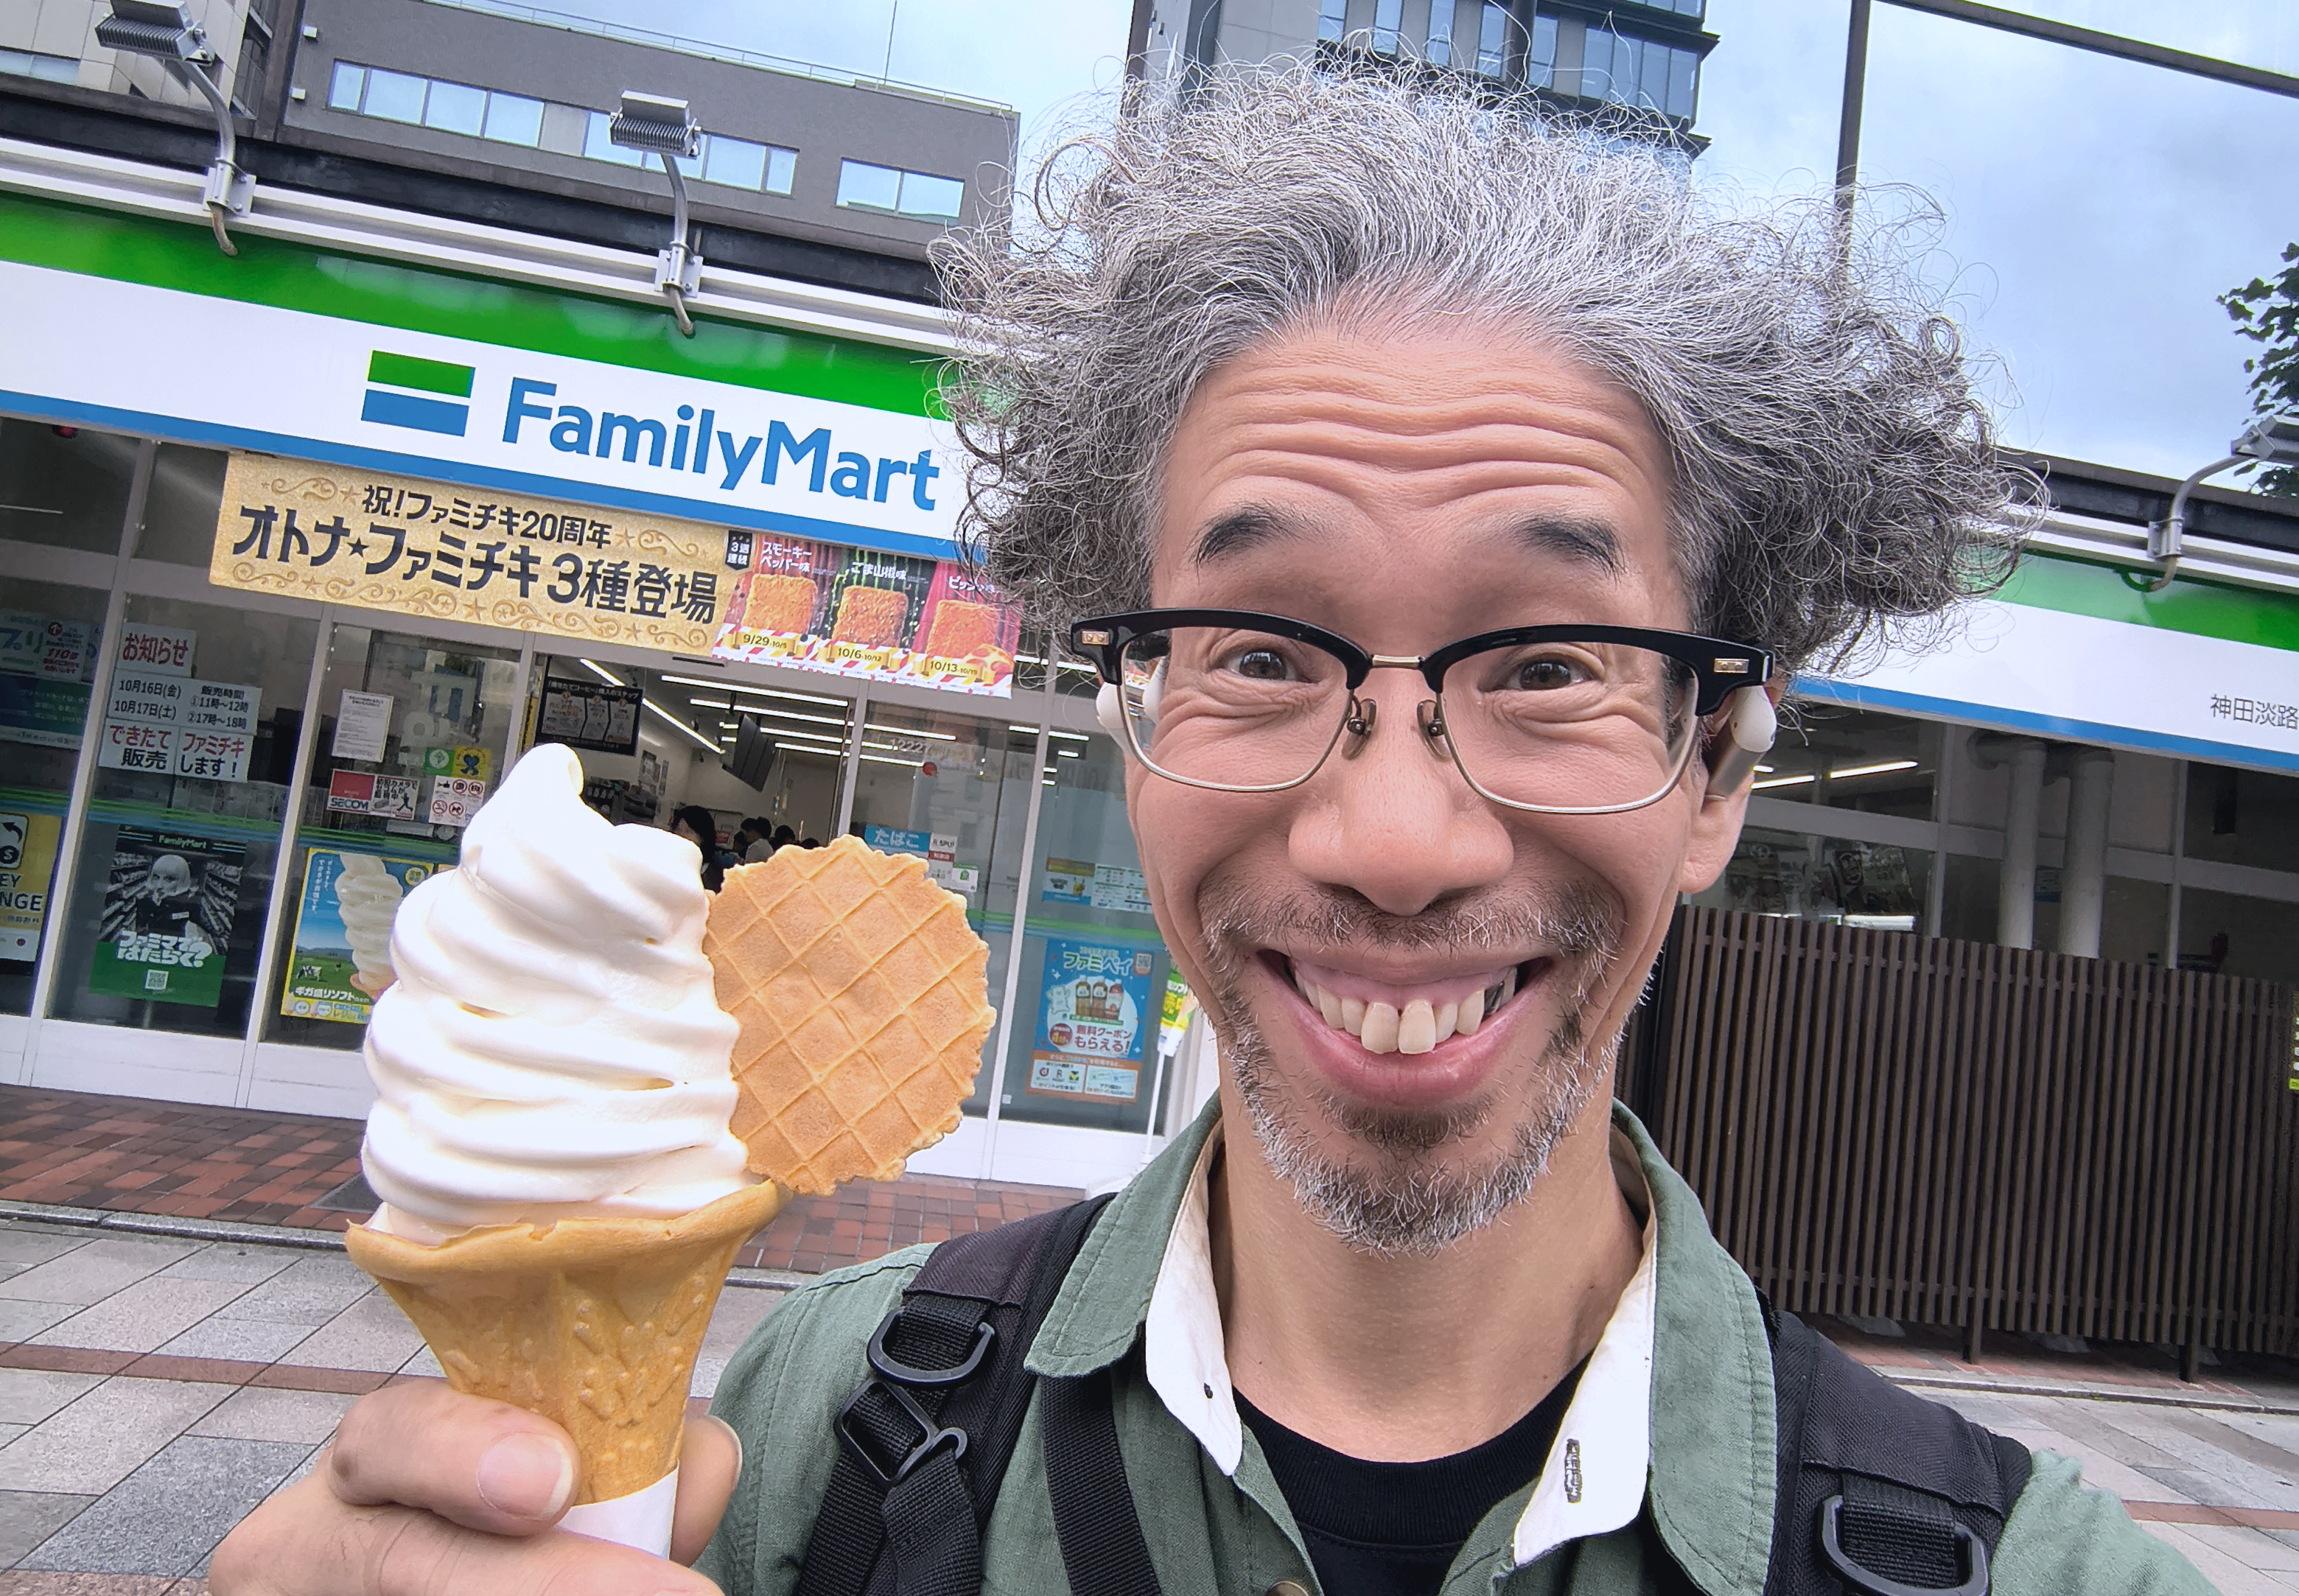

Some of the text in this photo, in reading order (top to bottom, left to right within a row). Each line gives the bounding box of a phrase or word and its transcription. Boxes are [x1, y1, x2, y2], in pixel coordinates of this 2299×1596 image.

[503, 377, 939, 511] FamilyMart
[362, 485, 612, 549] 祝!ファミチキ20周年
[761, 541, 812, 559] スモーキー
[760, 554, 811, 573] ペッパー味
[852, 561, 907, 581] ごま山椒味
[123, 633, 189, 666] お知らせ
[119, 679, 181, 700] 10月16日(金)
[114, 700, 177, 721] 10月17日(土)
[2210, 693, 2298, 730] 神田淡路
[110, 725, 172, 750] できたて
[183, 732, 245, 758] ファミチキ
[121, 747, 168, 771] 販売
[330, 797, 368, 811] SECOM
[158, 834, 207, 850] FamilyMart
[873, 828, 920, 849] たばこ
[1063, 951, 1134, 976] ファミペイ
[1076, 1024, 1133, 1040] 無料クーポン
[1074, 1035, 1130, 1054] もらえる!
